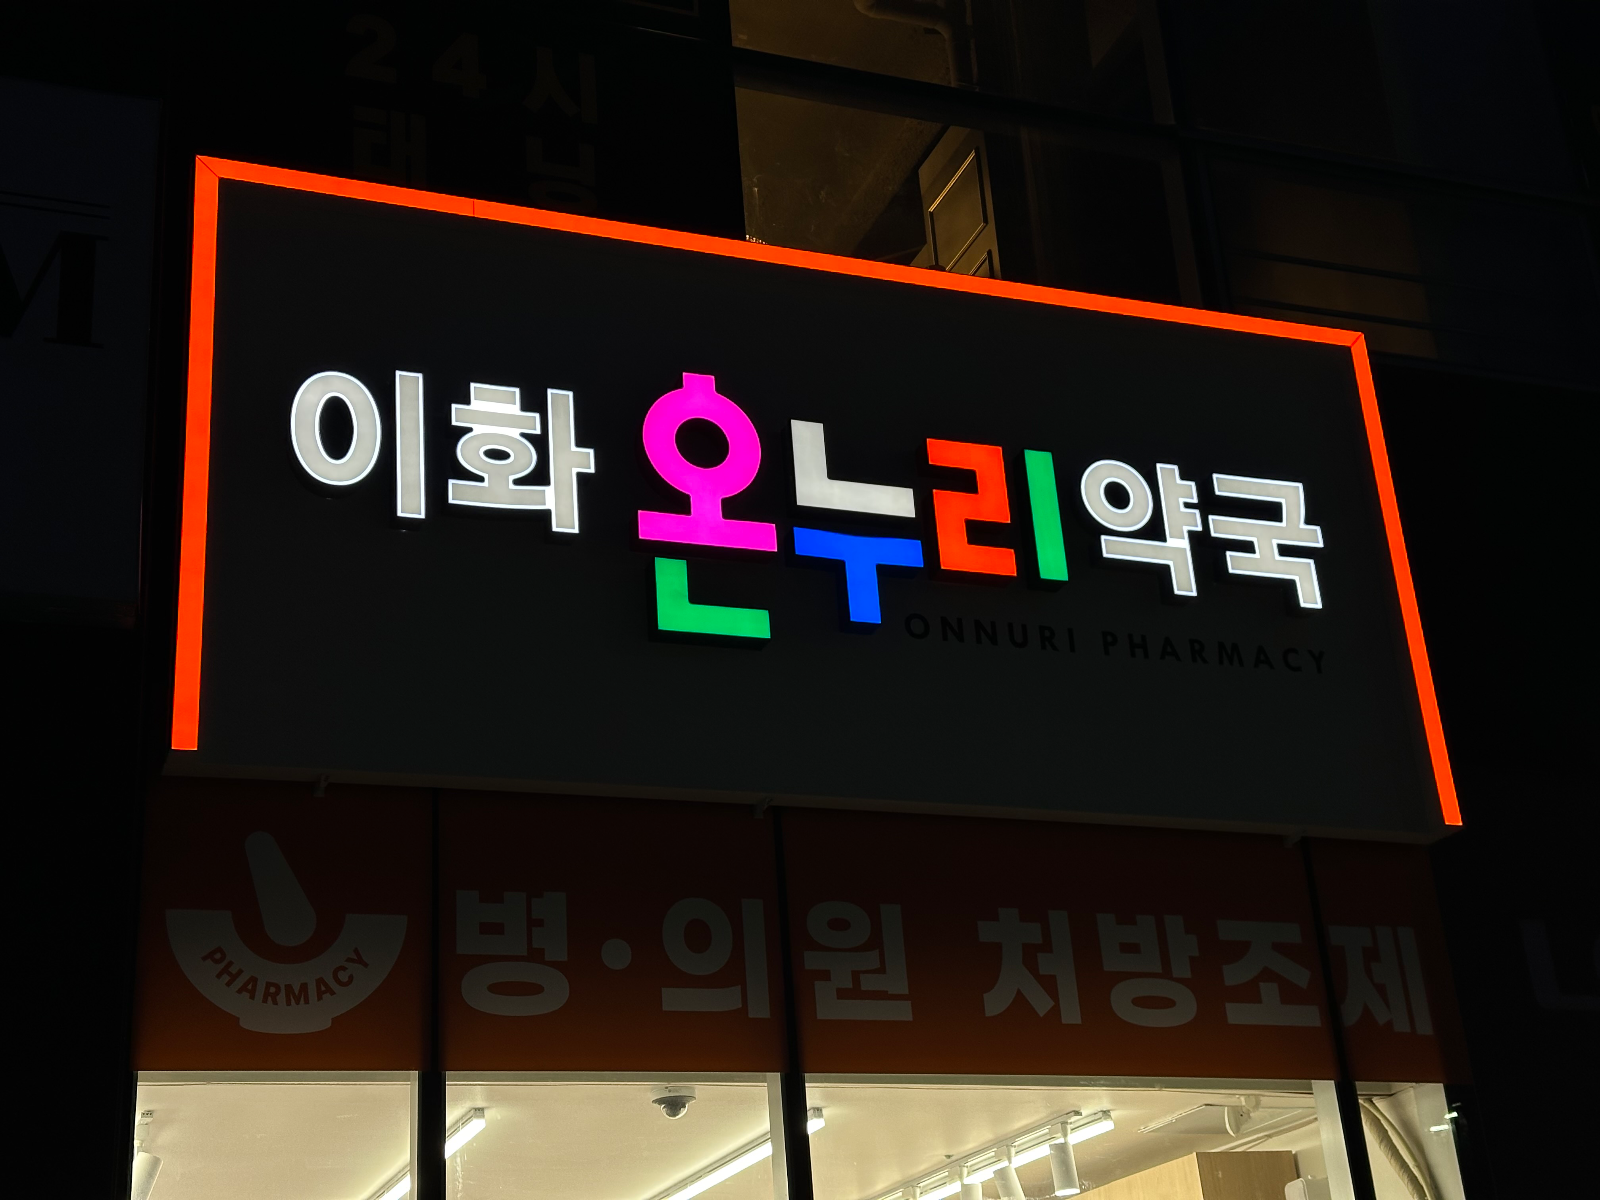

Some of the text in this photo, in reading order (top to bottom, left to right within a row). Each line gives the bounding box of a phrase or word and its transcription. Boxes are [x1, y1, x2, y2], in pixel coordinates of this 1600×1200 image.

[290, 369, 596, 534] 이화
[904, 612, 1325, 675] ONNURI PHARMACY
[200, 946, 369, 1007] PHARMACY
[977, 906, 1435, 1036] 처방조제
